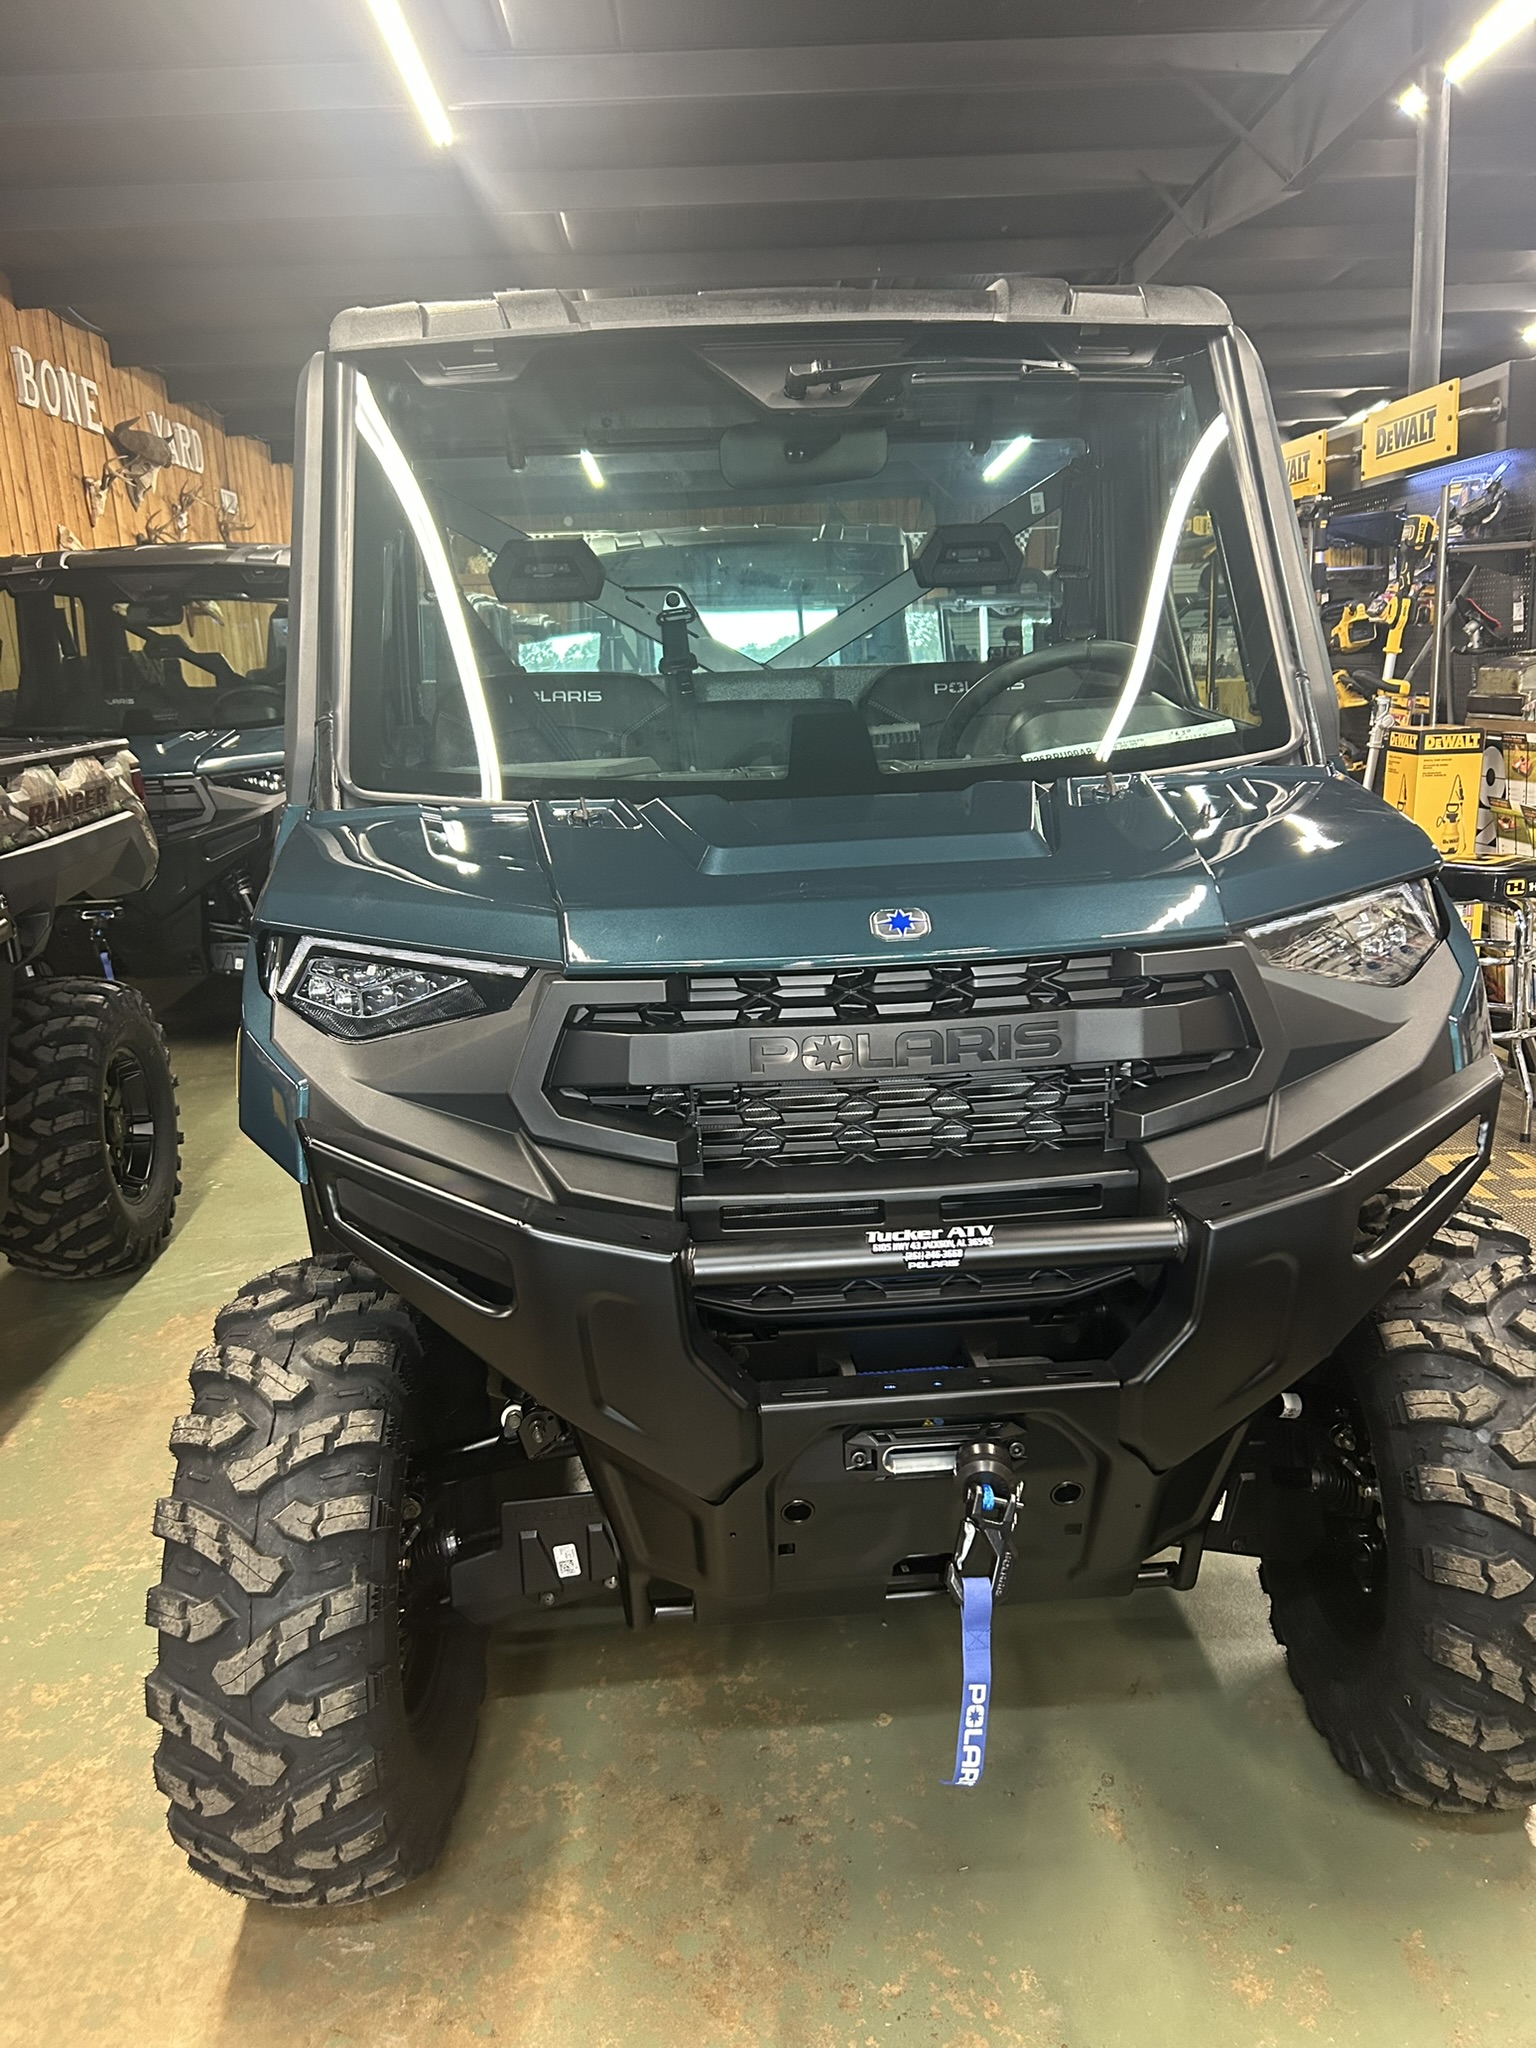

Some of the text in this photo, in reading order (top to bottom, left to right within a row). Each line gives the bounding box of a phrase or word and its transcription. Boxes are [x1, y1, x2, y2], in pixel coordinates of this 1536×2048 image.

[10, 346, 104, 435] BONE
[509, 690, 602, 703] LARIS
[28, 786, 108, 829] RANGER
[749, 1021, 1063, 1075] POLARIS
[865, 1225, 994, 1243] Tucker ATV
[908, 1259, 960, 1269] POLARIS
